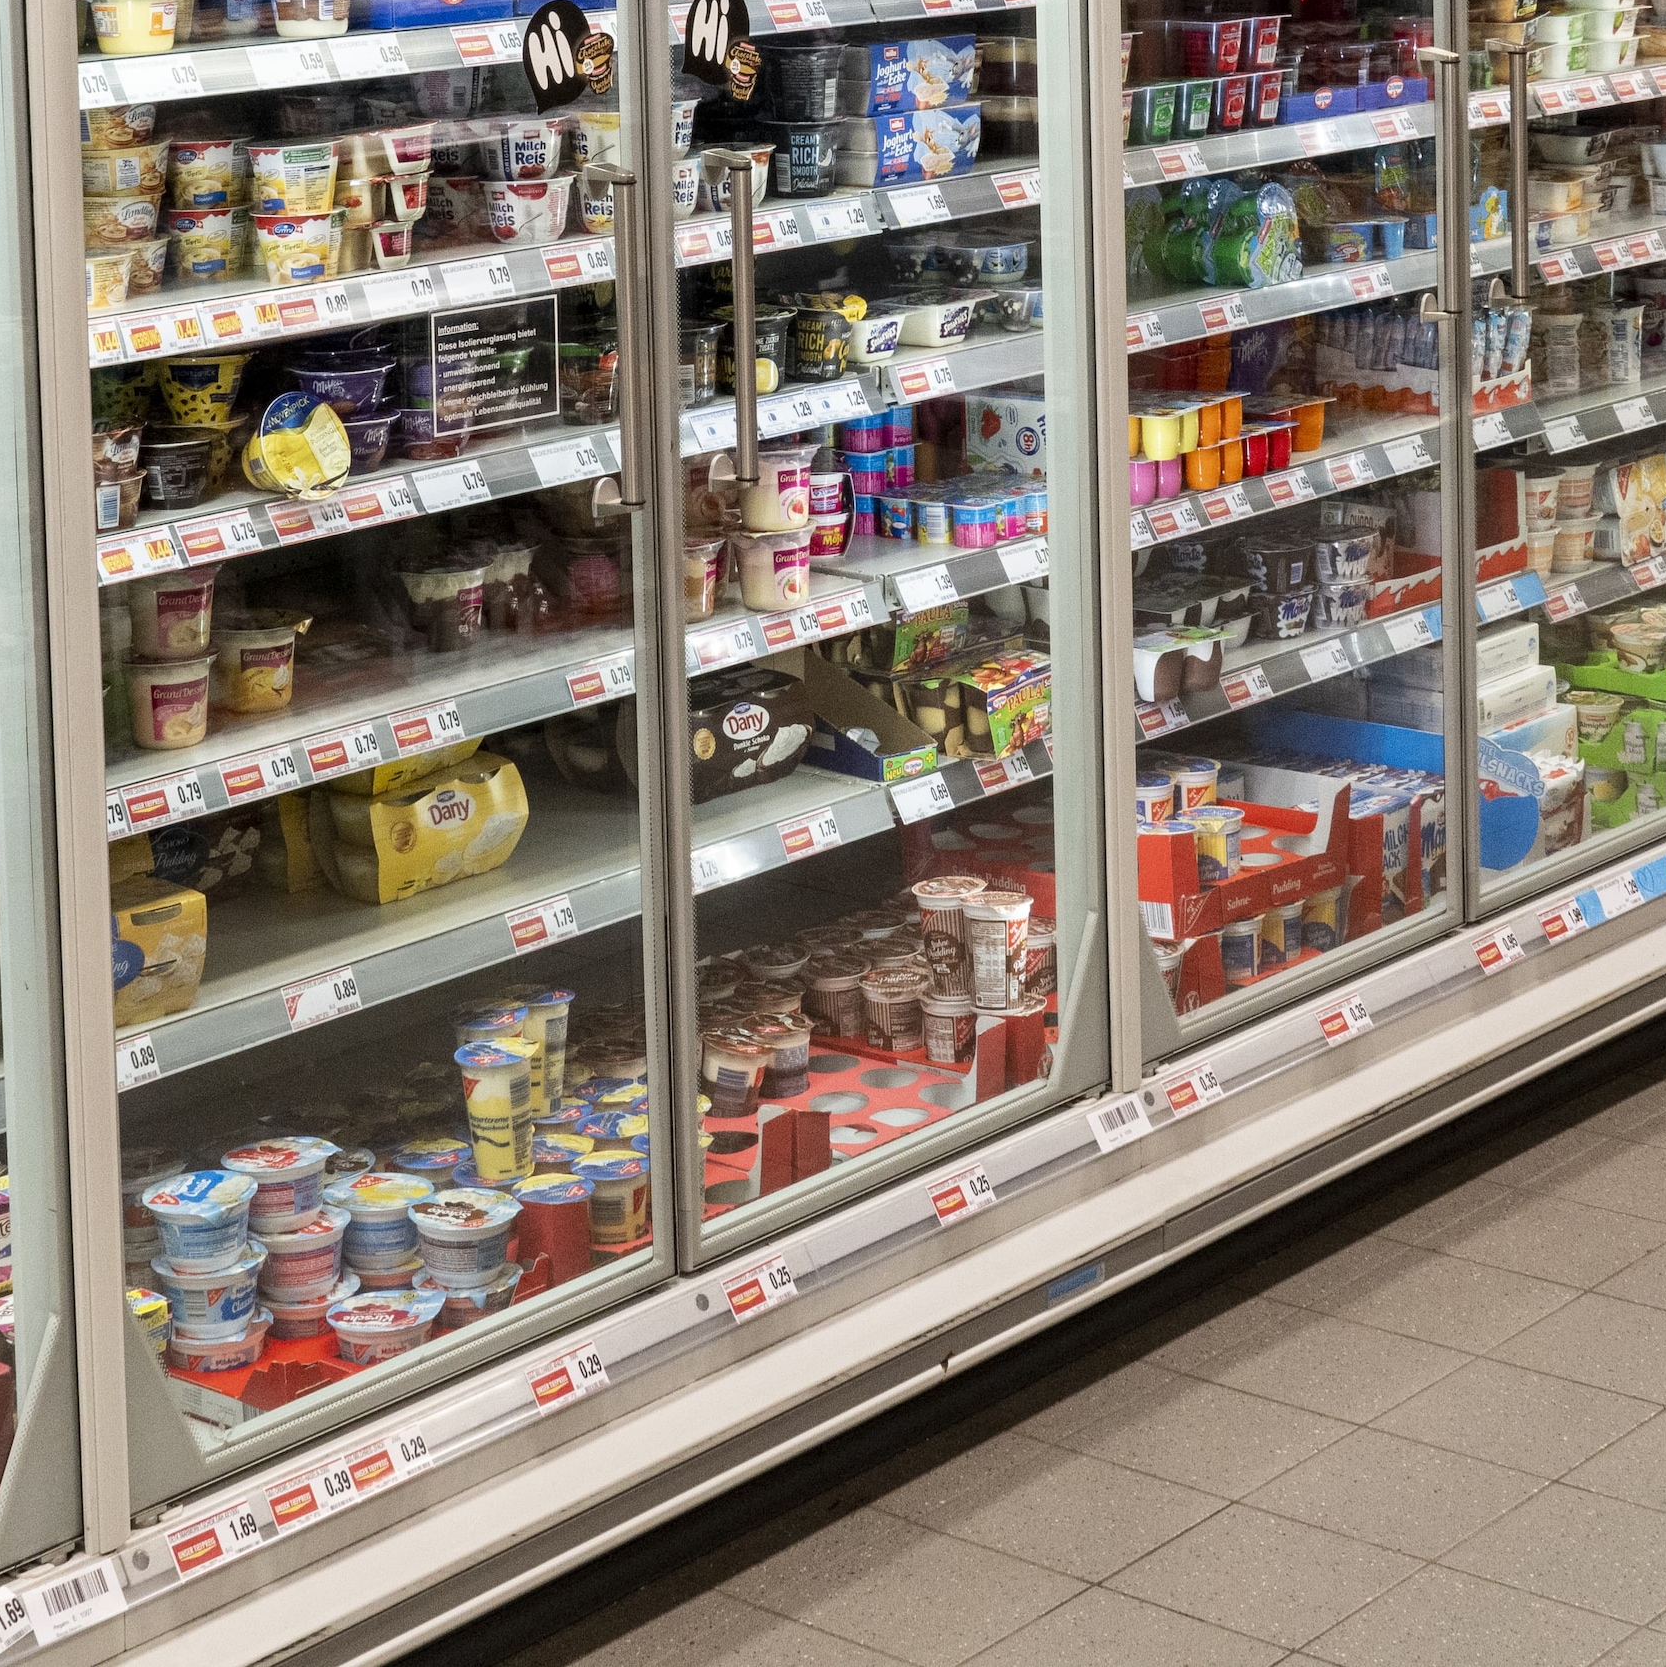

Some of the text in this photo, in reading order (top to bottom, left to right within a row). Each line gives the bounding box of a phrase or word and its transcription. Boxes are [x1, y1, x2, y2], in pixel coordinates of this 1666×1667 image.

[530, 9, 576, 91] Hi
[874, 58, 907, 80] Joghurt
[888, 72, 906, 87] Ecke
[514, 139, 548, 156] Milch
[882, 128, 916, 151] Joghurt
[792, 146, 819, 163] RICH
[894, 141, 913, 157] Ecke
[515, 152, 546, 167] Reis
[791, 164, 818, 177] SMOOTH
[488, 202, 515, 215] Milch
[489, 212, 516, 227] Reis
[292, 266, 324, 279] Classic
[438, 322, 479, 336] Information:
[438, 329, 536, 351] Diese Isolierverglasung bietet
[798, 333, 824, 351] RICH
[438, 347, 497, 363] folgende Vorteile:
[443, 361, 500, 378] umweltschonend
[934, 367, 952, 383] 0.75
[444, 376, 495, 393] energiesparend
[444, 382, 548, 407] immer gleichbleibende Kühlung
[444, 397, 541, 423] optimale Lebensmittelqualität
[915, 603, 952, 626] PAULA
[1007, 681, 1046, 712] PAULA
[728, 713, 765, 736] Dany
[429, 795, 470, 828] Dany
[769, 1266, 792, 1290] 0.25
[400, 1437, 427, 1462] 0.29
